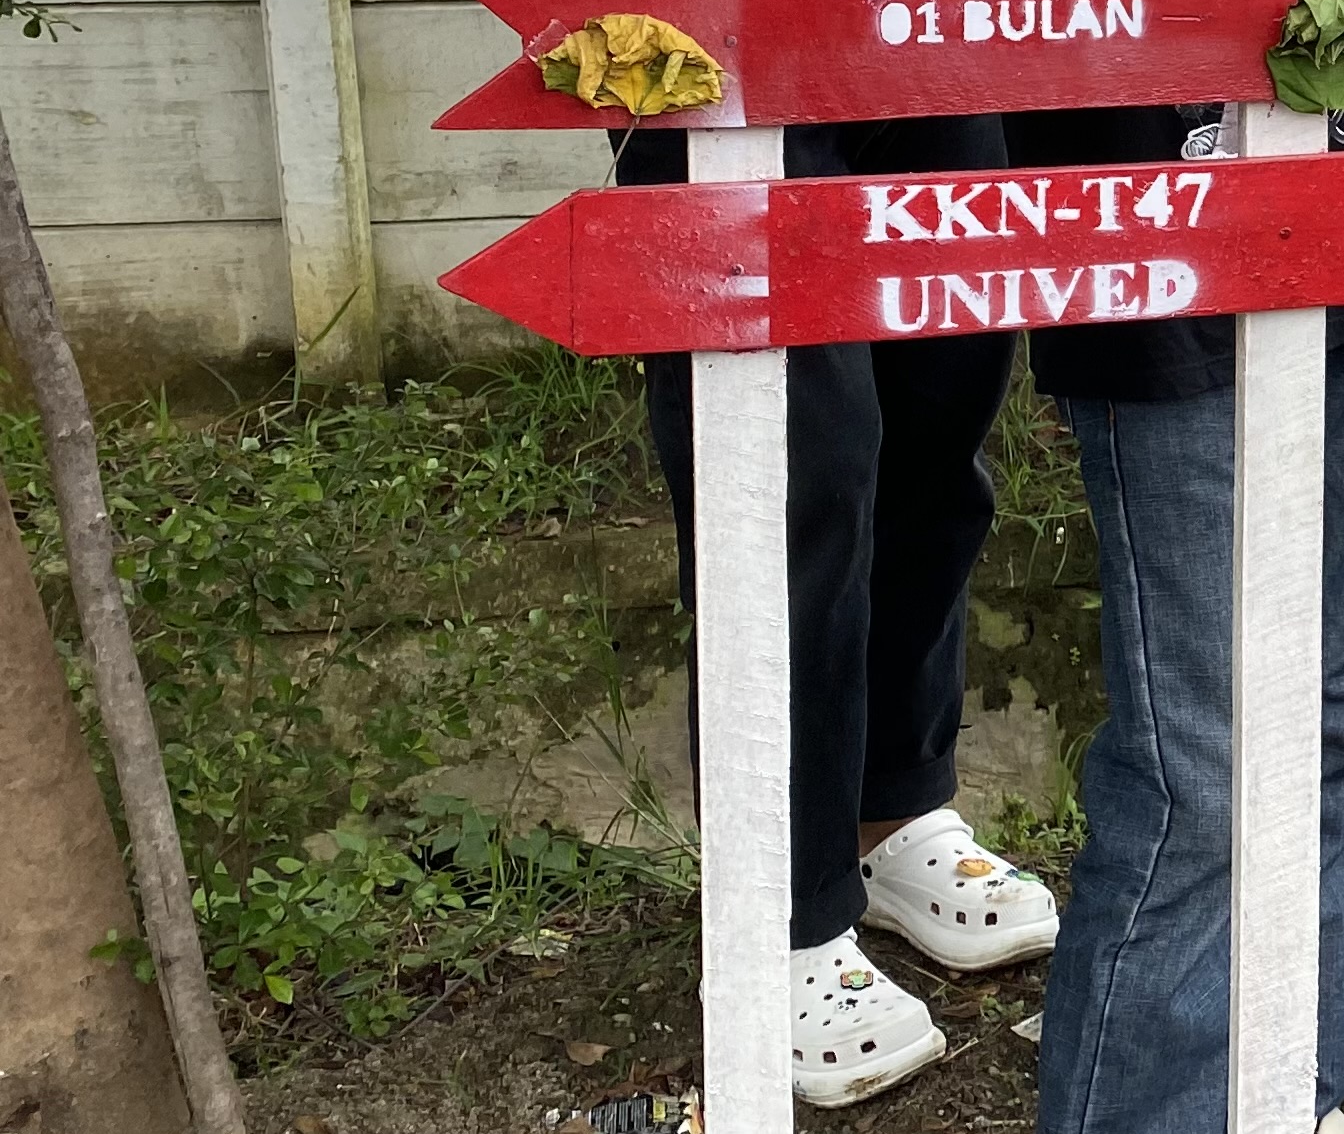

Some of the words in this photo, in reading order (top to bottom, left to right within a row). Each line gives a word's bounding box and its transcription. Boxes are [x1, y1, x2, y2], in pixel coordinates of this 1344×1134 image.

[878, 1, 945, 44] 01
[861, 172, 1213, 244] KKN-T47
[877, 260, 1200, 333] UNIVED
